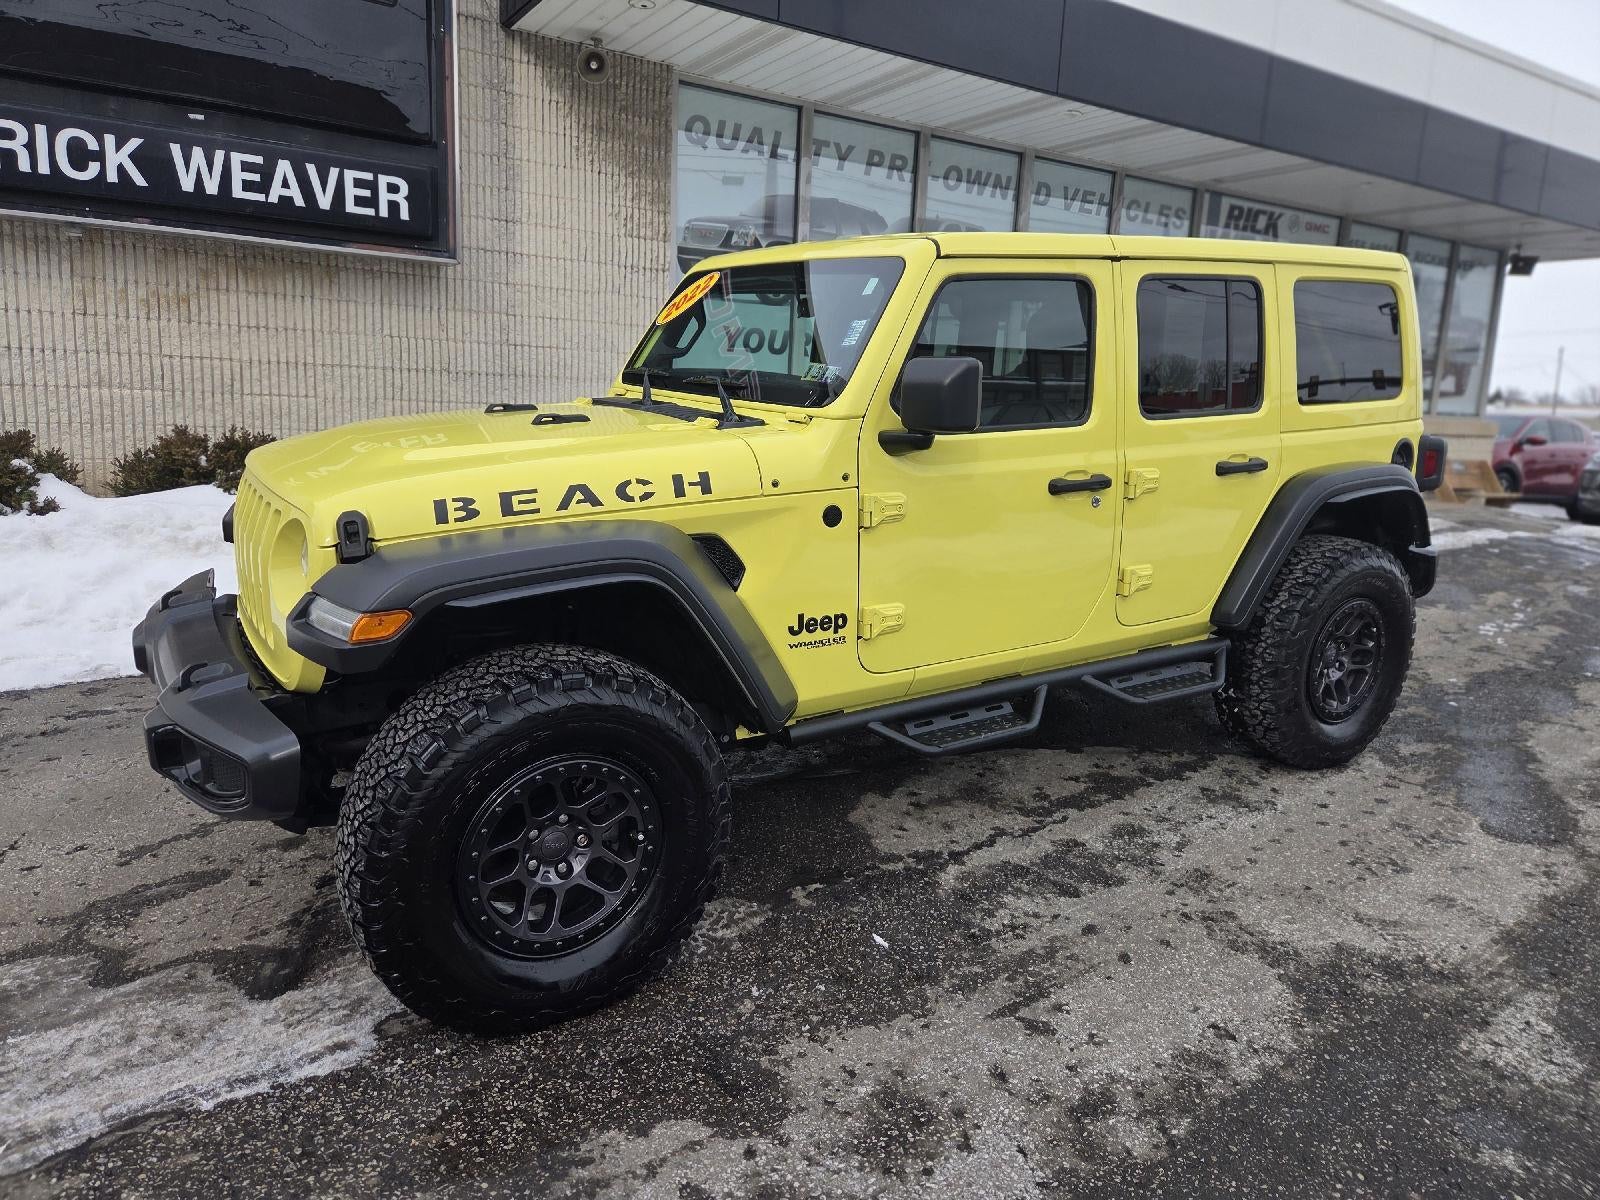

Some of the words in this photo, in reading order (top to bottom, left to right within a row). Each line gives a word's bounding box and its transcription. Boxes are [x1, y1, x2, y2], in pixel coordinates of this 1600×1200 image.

[684, 114, 856, 171] QUALTY
[0, 118, 149, 187] RICK
[169, 143, 410, 220] WEAVER
[1224, 203, 1285, 239] RICK
[1304, 221, 1330, 234] GMC
[661, 273, 716, 322] 2022
[432, 471, 713, 526] BEACH
[787, 613, 848, 637] Jeep
[788, 636, 847, 650] WRANGLER
